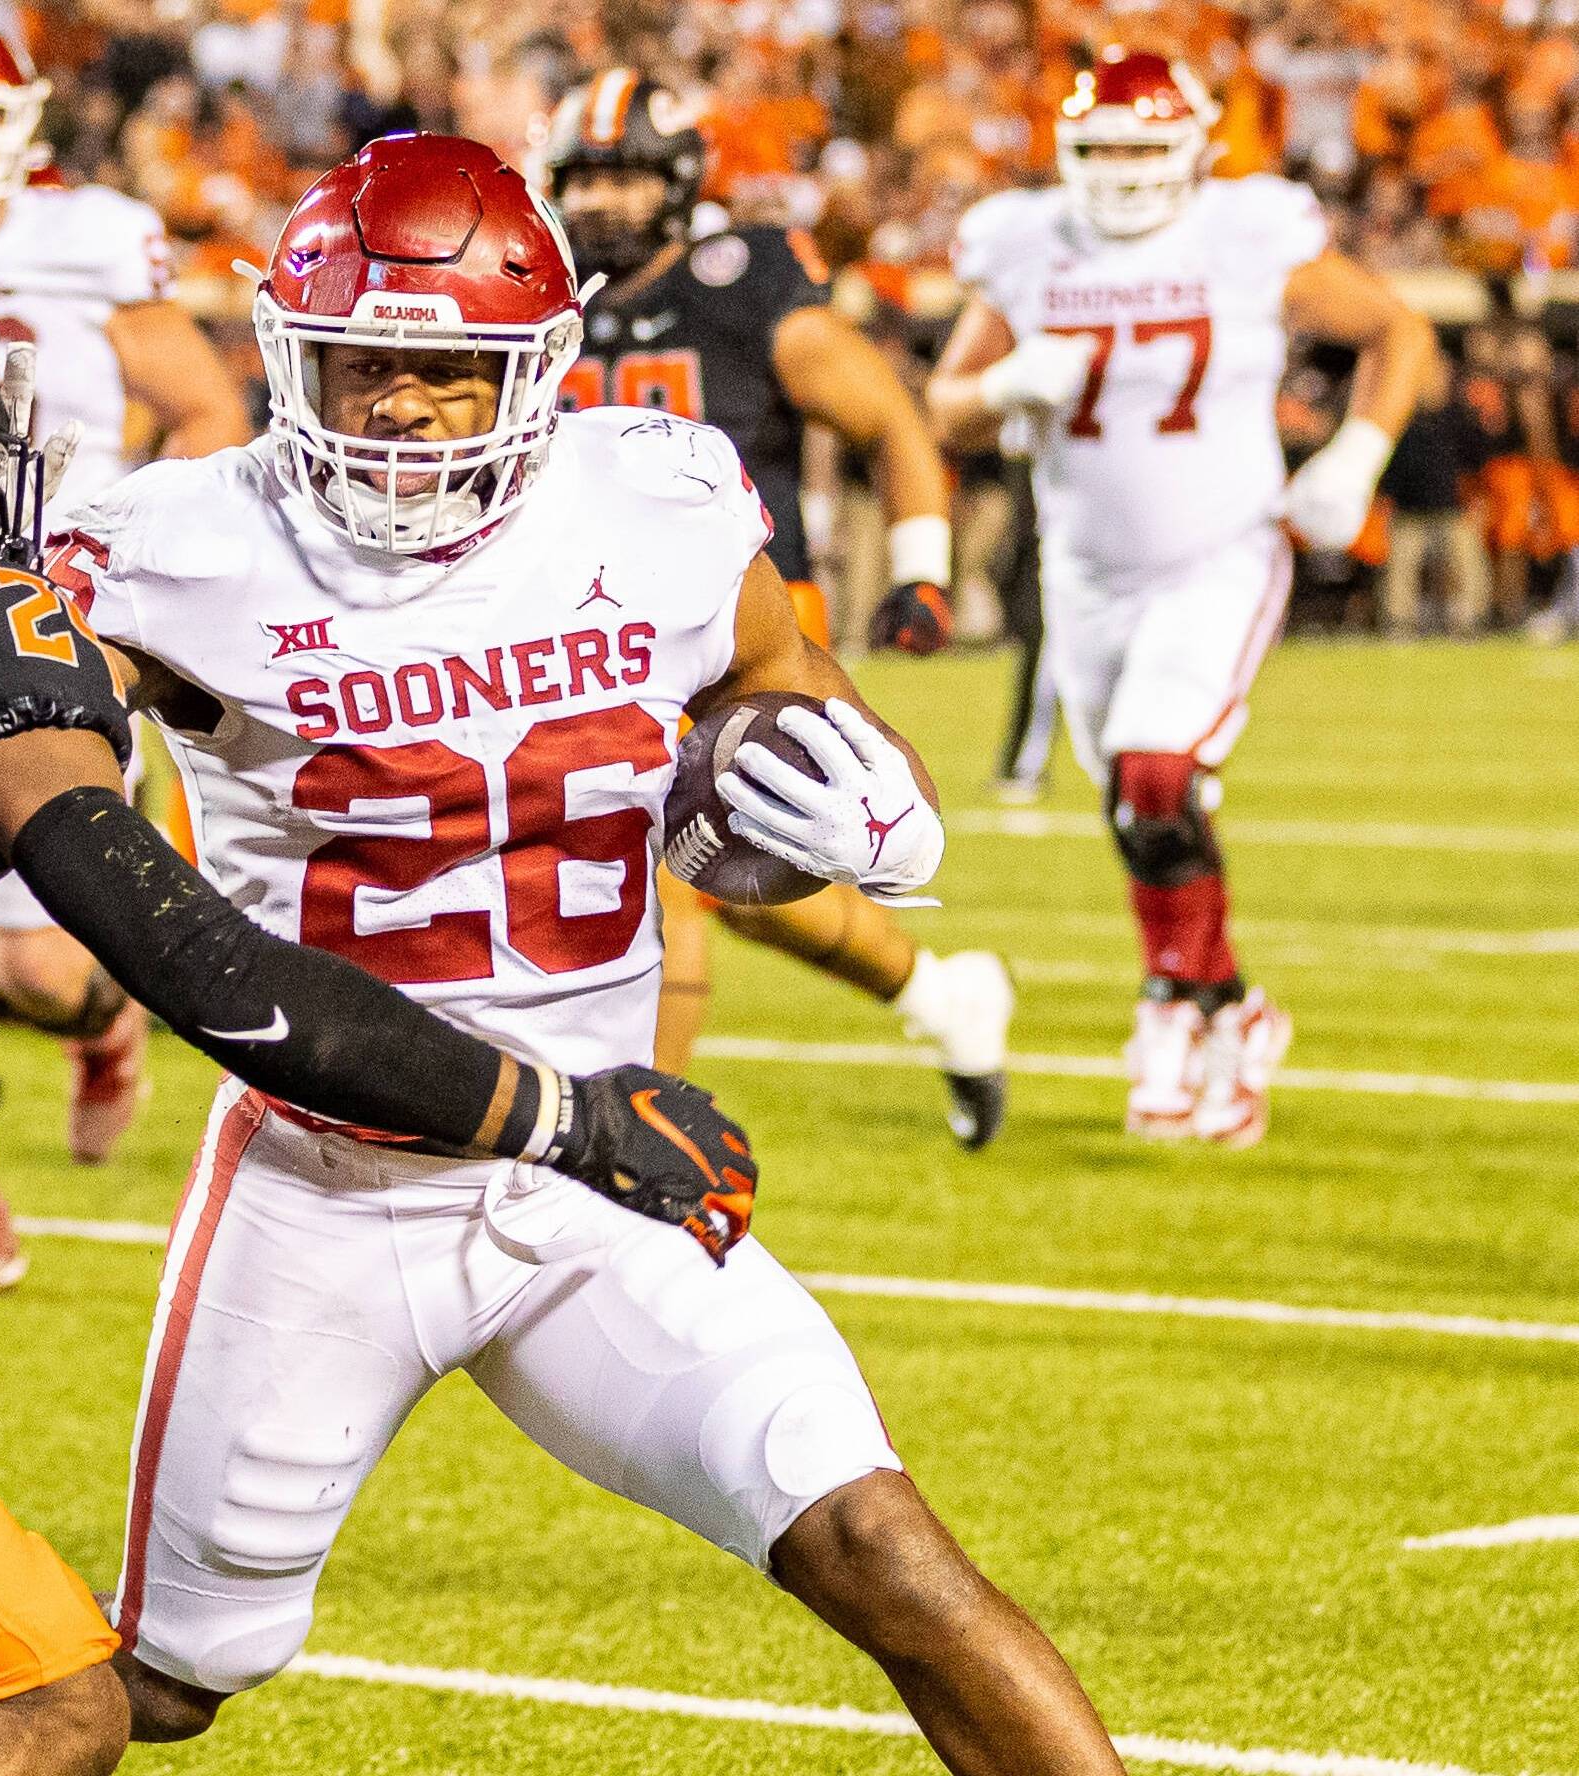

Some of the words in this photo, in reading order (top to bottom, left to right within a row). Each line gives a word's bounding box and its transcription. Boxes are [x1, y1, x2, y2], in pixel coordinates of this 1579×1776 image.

[374, 305, 438, 322] OKLAHOMA
[1040, 314, 1214, 440] 77
[267, 616, 339, 659] XII
[285, 621, 657, 743] SOONERS
[292, 701, 673, 985] 26
